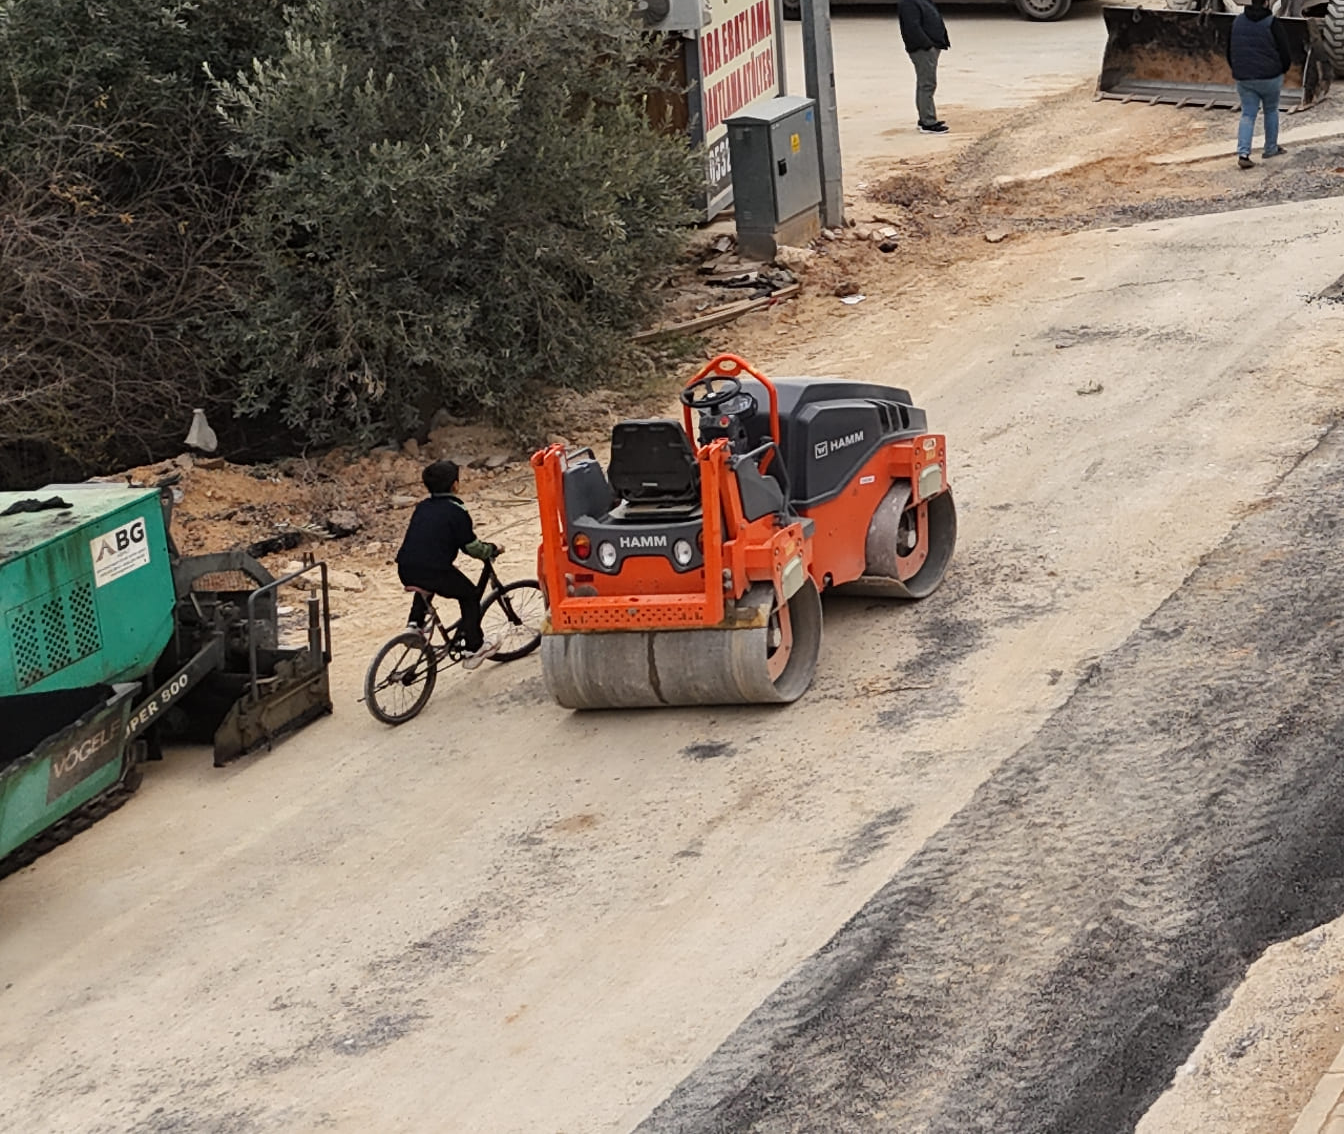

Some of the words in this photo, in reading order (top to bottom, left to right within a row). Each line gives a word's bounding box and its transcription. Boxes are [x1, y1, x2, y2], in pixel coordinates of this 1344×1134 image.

[829, 431, 865, 453] HAMM
[96, 521, 146, 563] ABG
[619, 535, 668, 549] HAMM
[161, 674, 188, 703] 800
